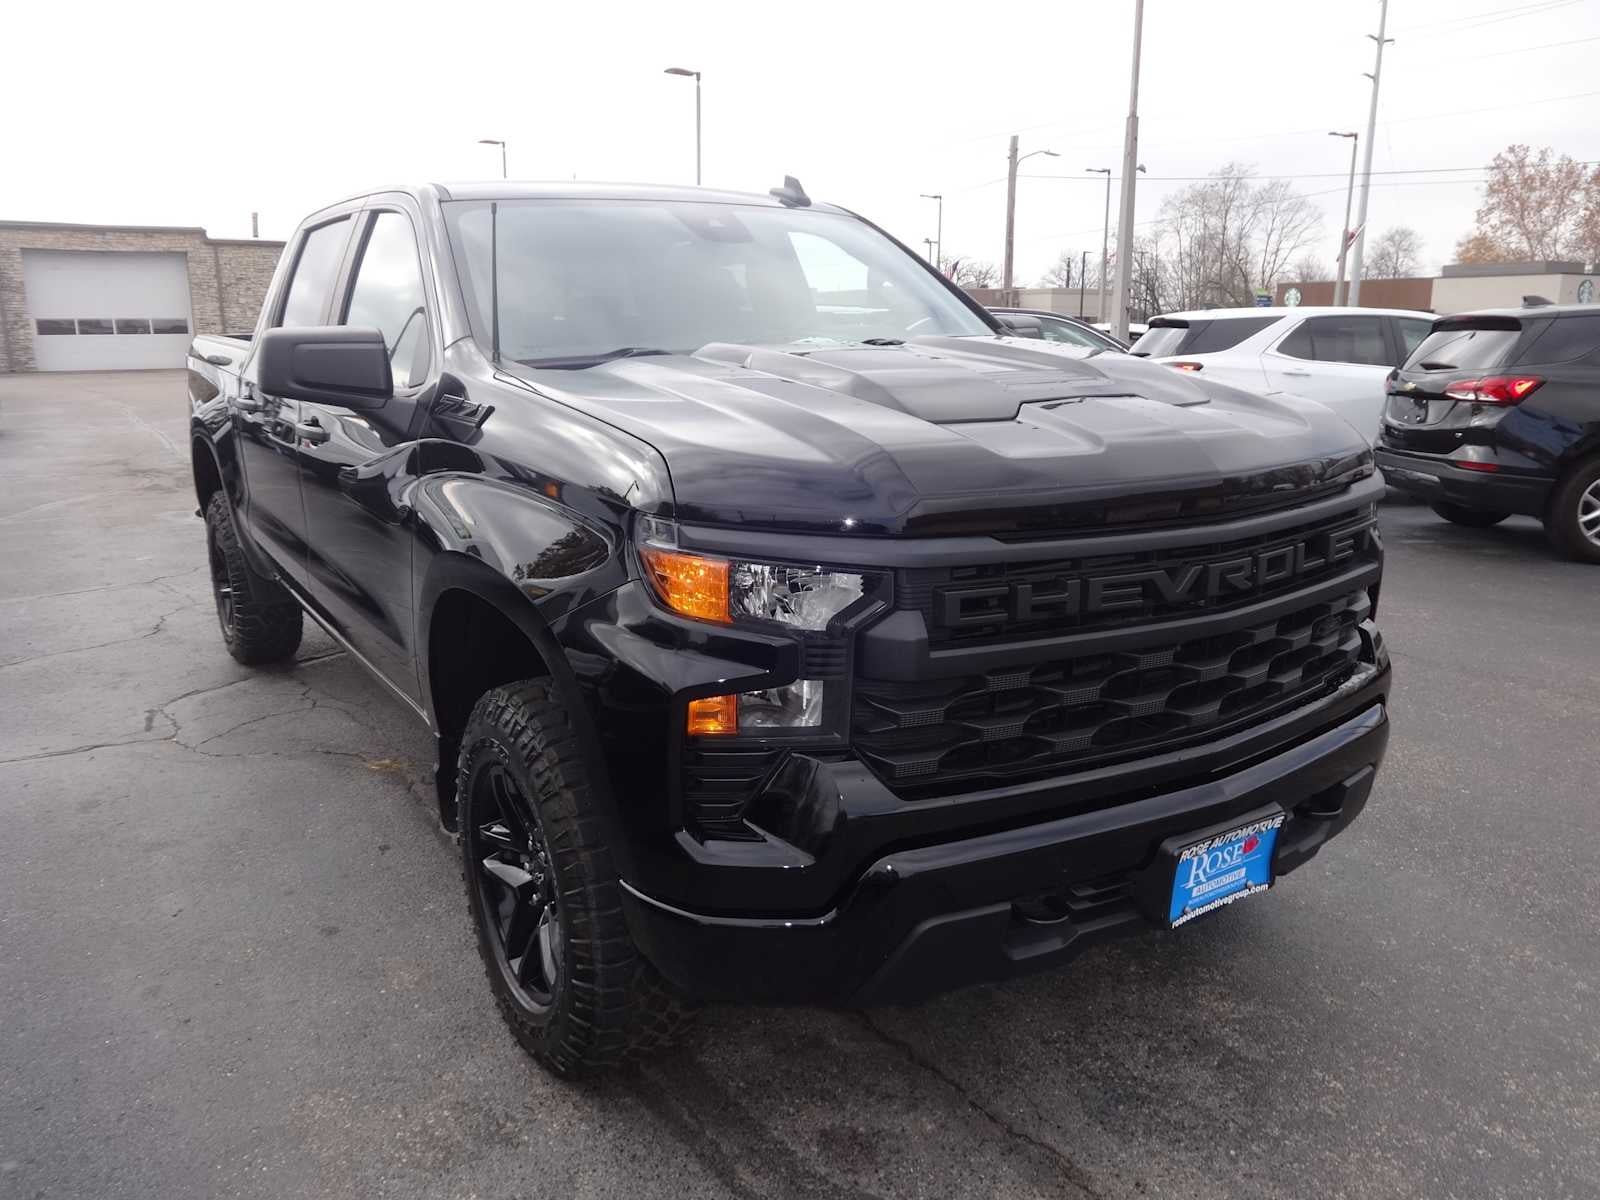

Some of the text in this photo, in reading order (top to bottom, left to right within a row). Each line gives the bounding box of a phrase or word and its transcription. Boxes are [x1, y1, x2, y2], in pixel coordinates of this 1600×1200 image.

[434, 394, 495, 428] Z71
[1179, 816, 1285, 864] ROSE AUTOMOTIVE
[1184, 843, 1242, 888] ROSE
[1171, 884, 1268, 929] roseautomotivegroup.com
